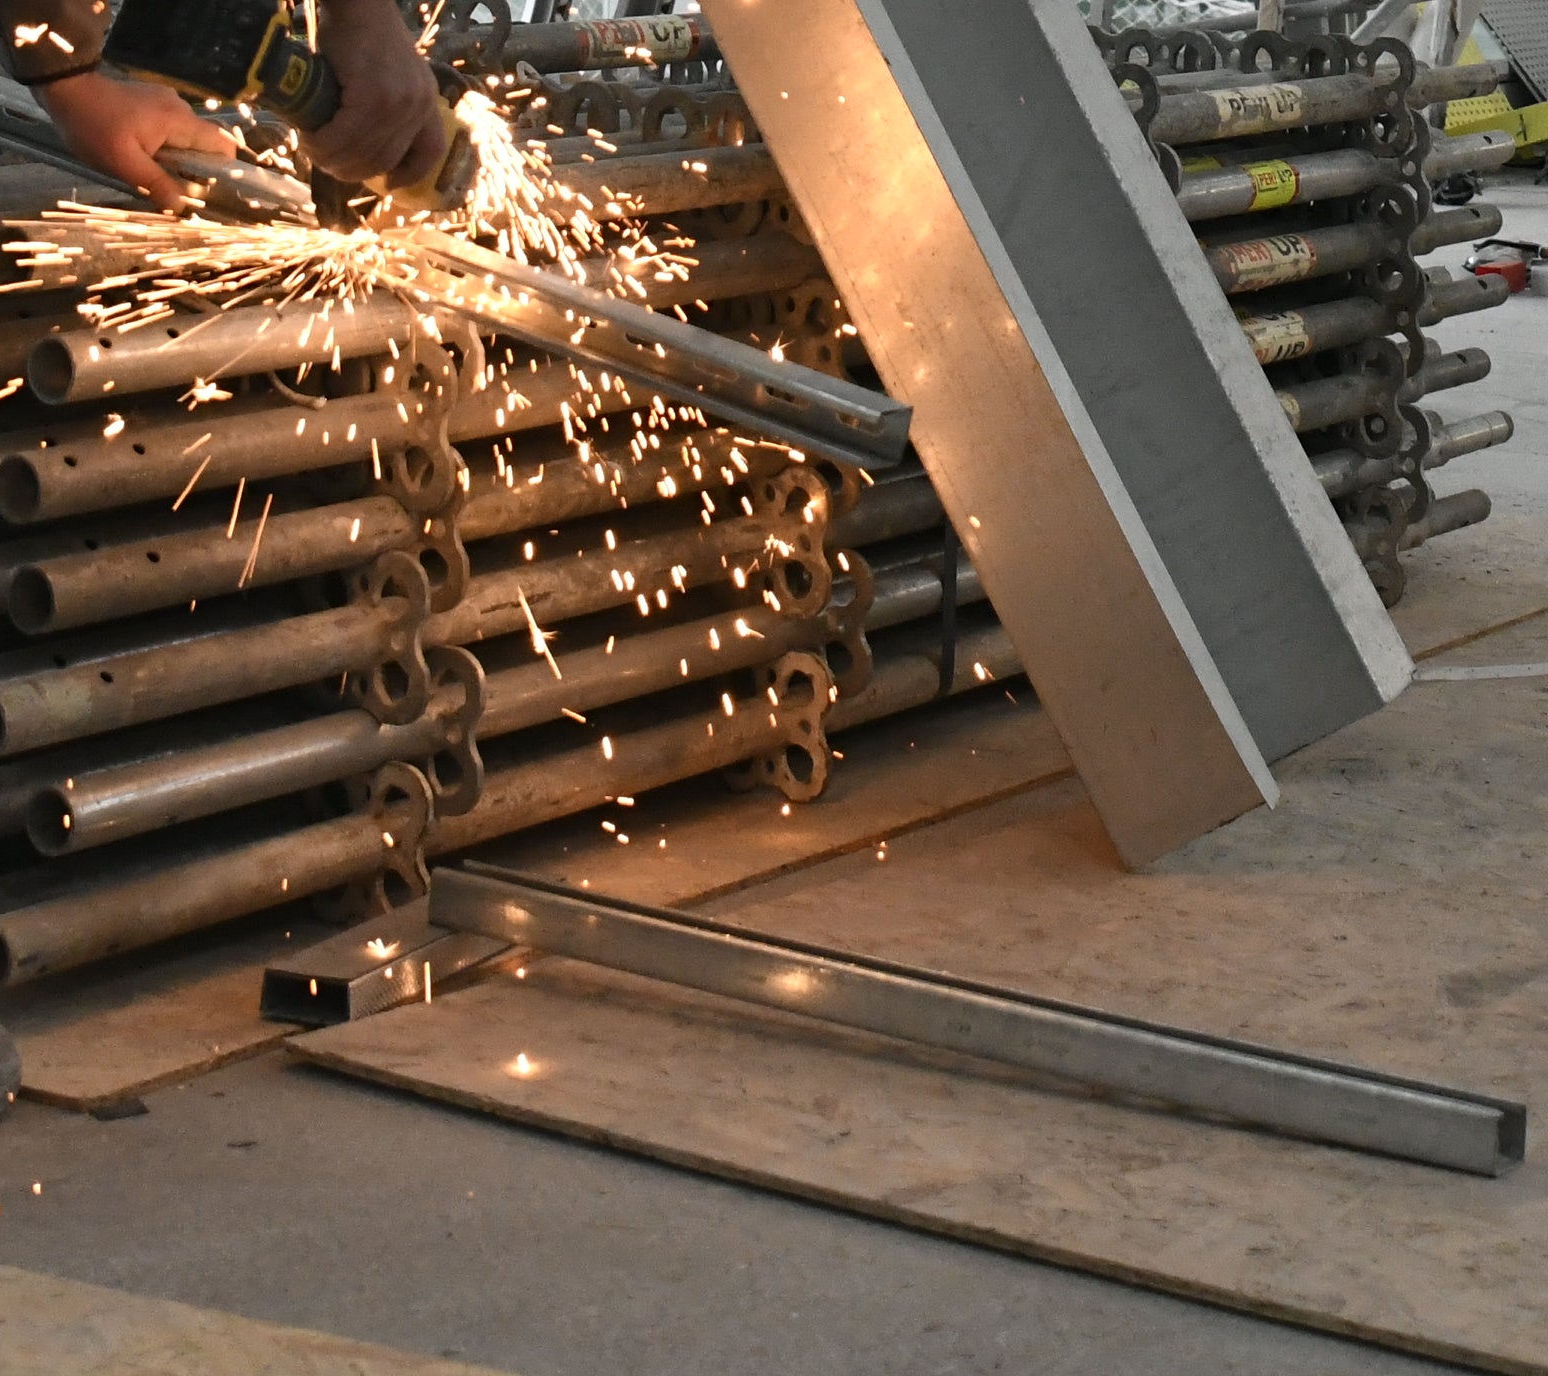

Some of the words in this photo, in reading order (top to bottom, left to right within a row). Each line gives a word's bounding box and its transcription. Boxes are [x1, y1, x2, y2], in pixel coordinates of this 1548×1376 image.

[593, 20, 646, 45] PEI
[1231, 240, 1272, 262] PERI
[1268, 234, 1302, 257] UP
